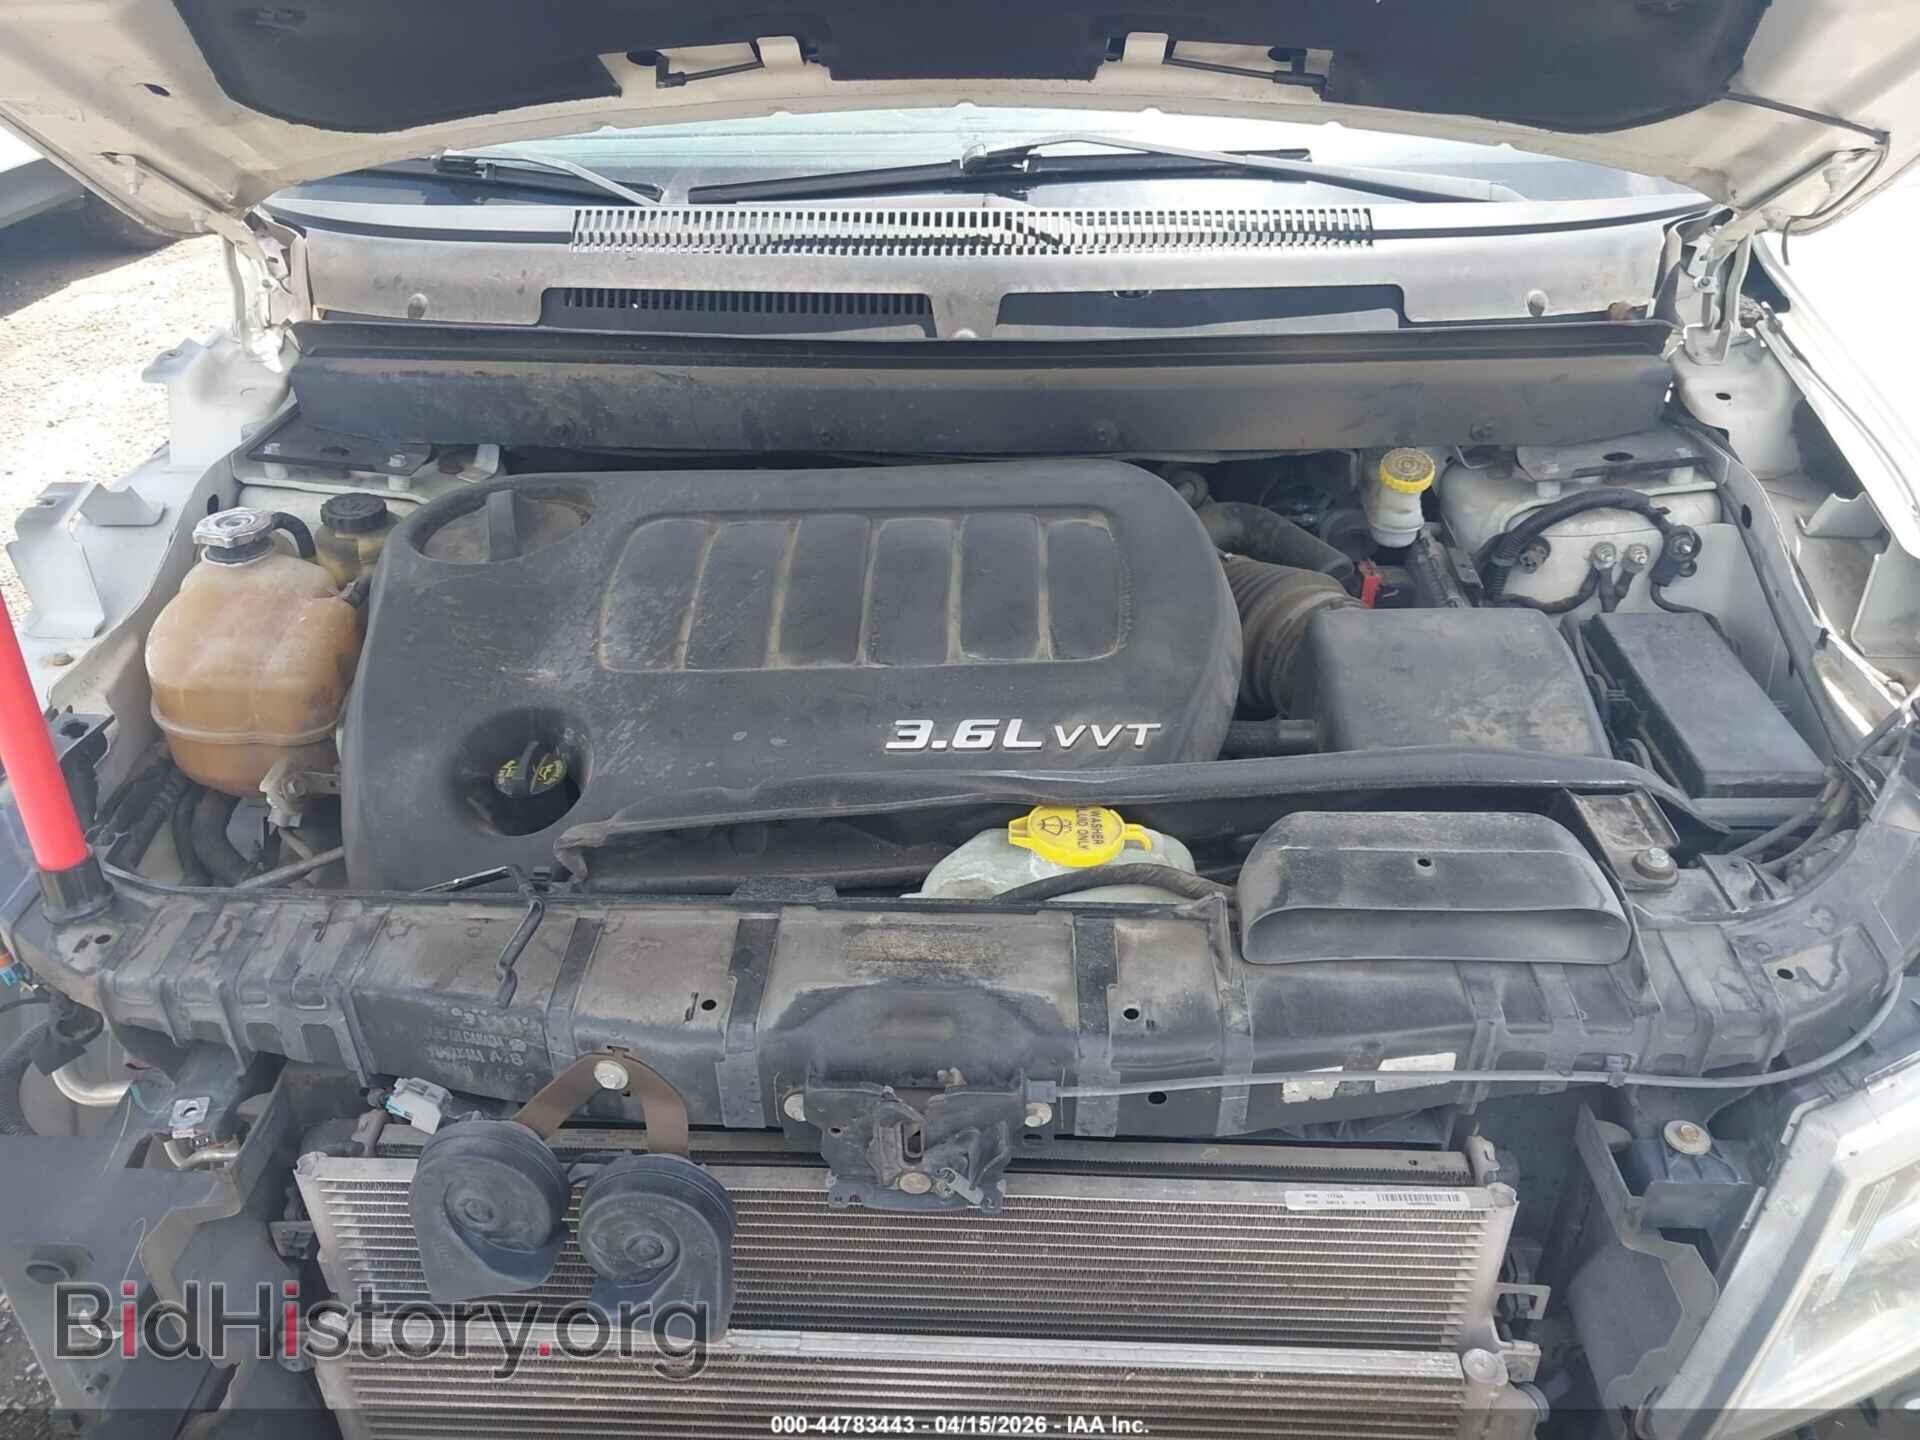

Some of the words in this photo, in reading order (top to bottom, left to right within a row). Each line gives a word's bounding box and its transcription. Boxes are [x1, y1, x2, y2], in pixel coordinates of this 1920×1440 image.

[885, 718, 1043, 750] 3.6L
[1054, 722, 1162, 748] VVT
[1077, 829, 1089, 850] ONLY
[1090, 809, 1104, 845] WASHER
